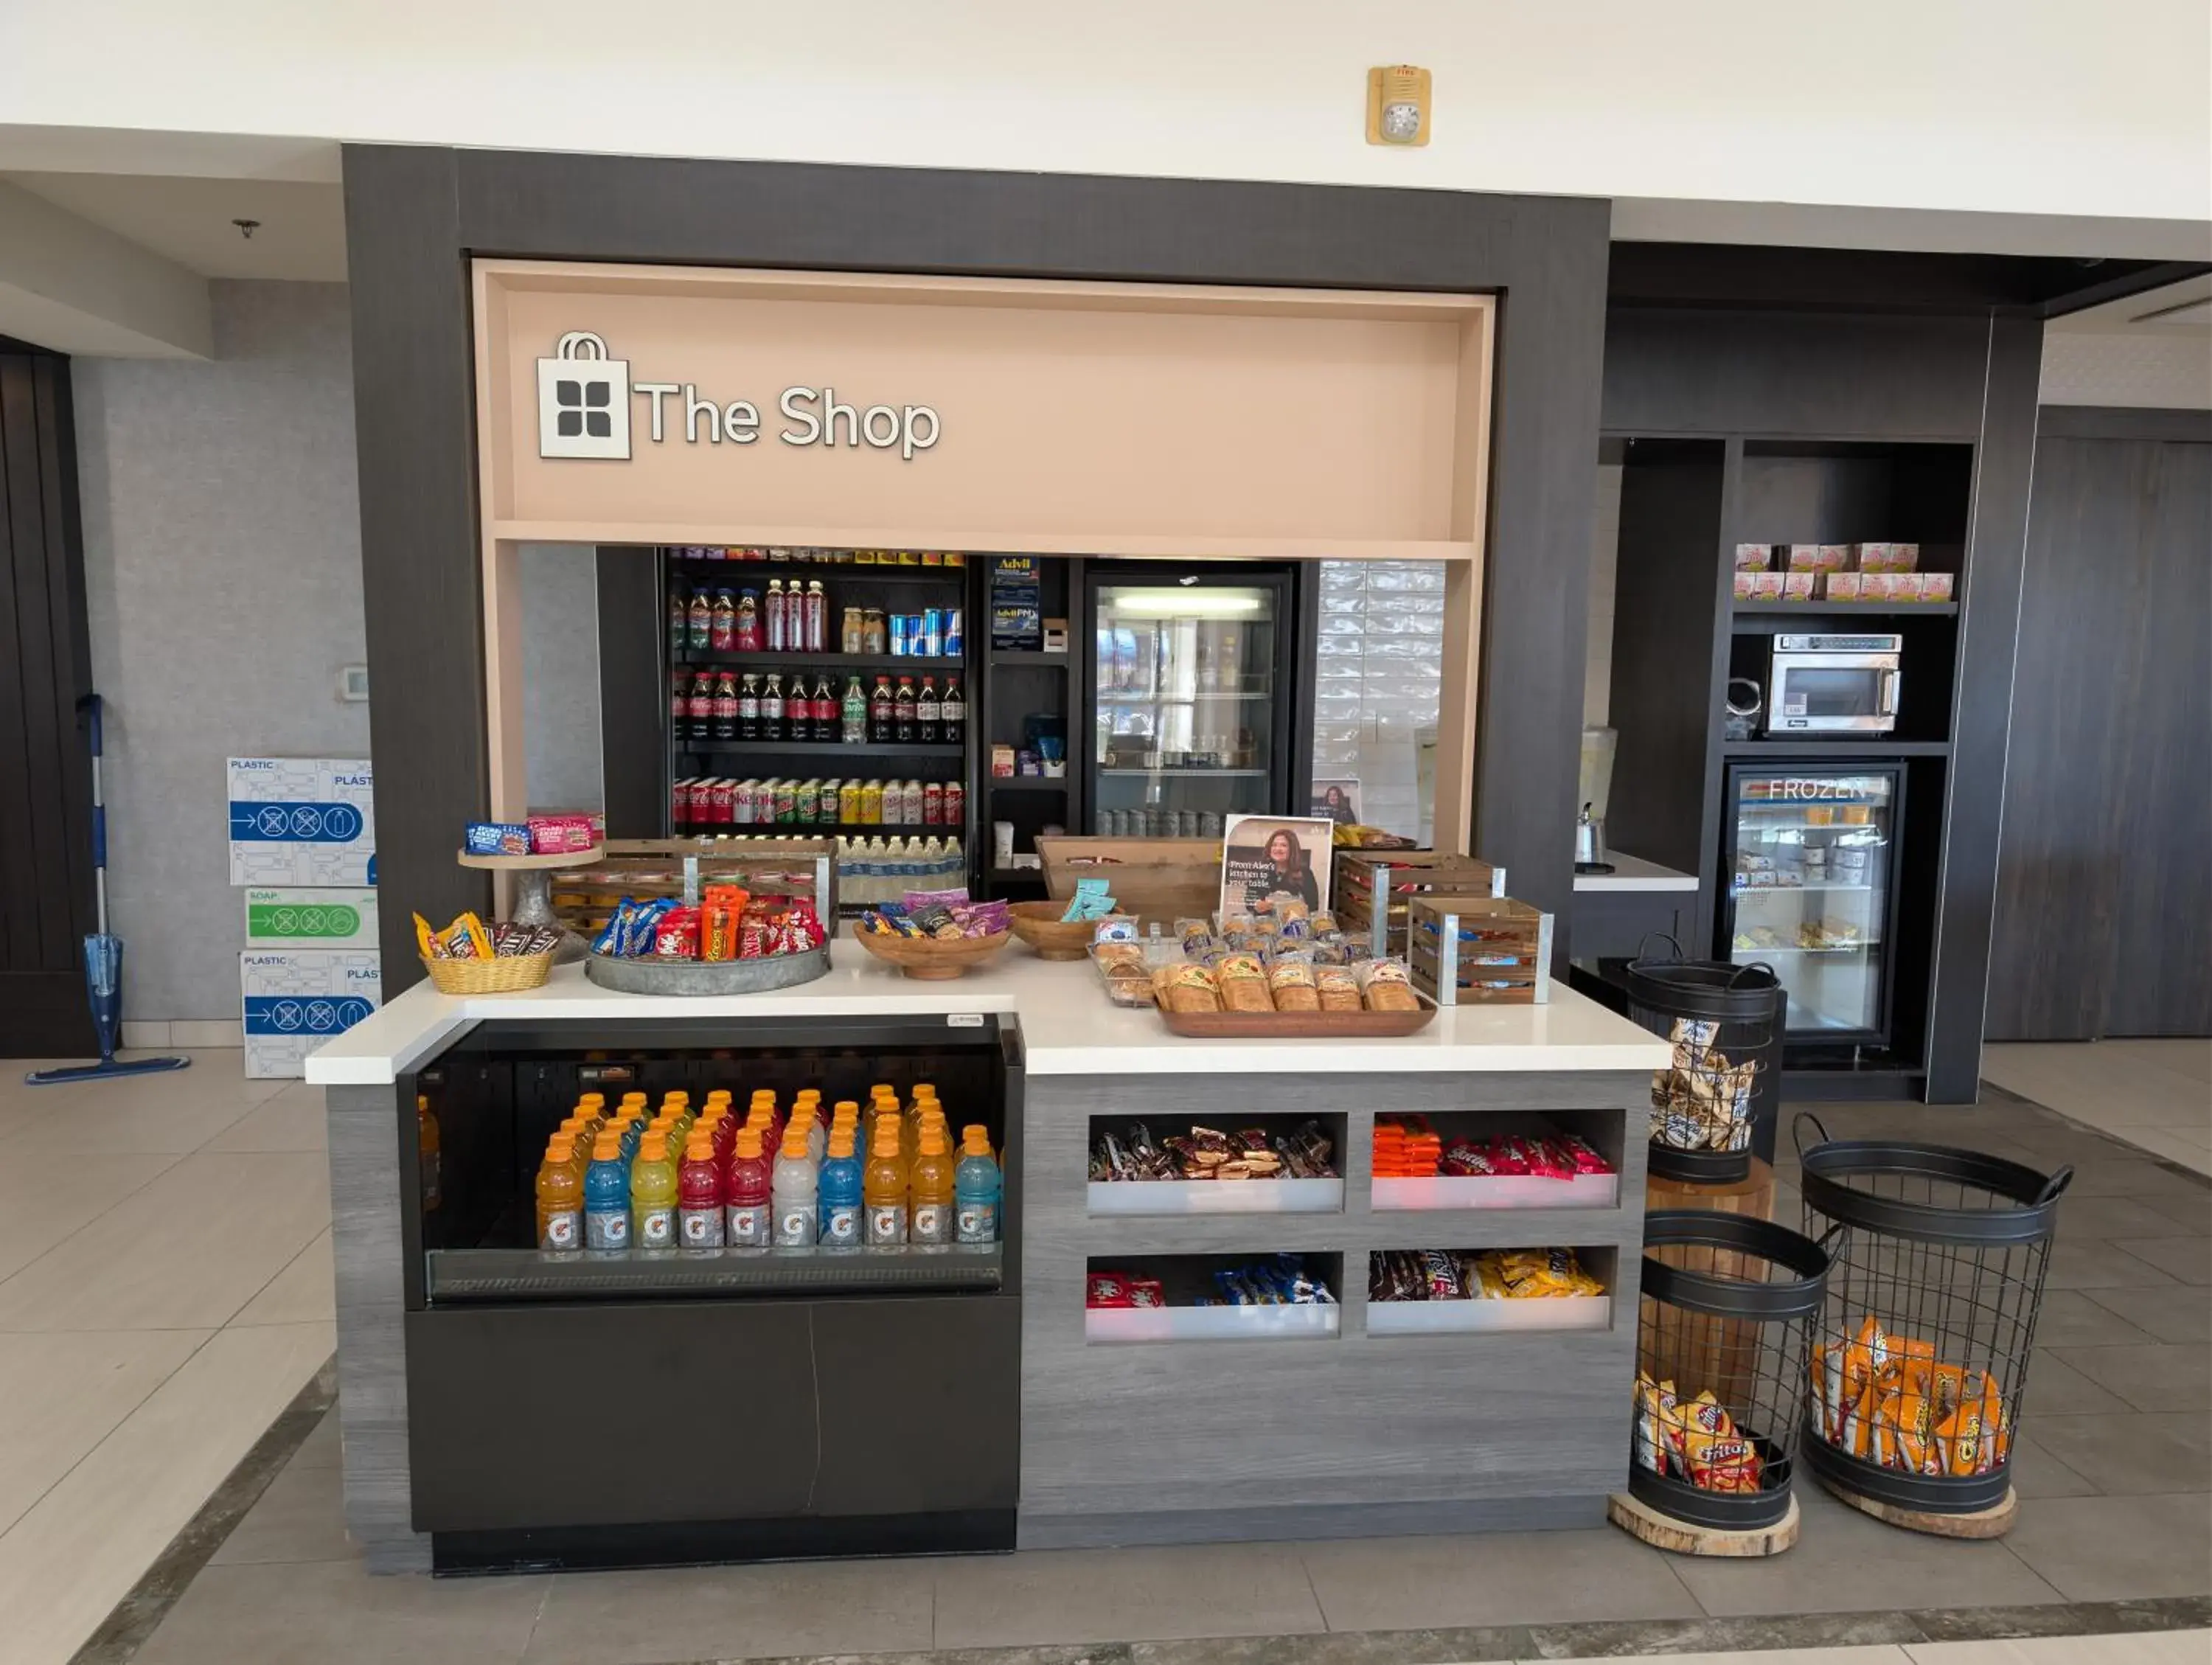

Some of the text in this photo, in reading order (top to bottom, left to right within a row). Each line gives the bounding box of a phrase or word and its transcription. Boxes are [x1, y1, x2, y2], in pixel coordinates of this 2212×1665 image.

[632, 382, 941, 460] The Shop
[999, 558, 1030, 569] Advil
[231, 760, 274, 769] PLASTIC
[334, 774, 373, 785] PLÁST
[1770, 779, 1866, 799] FROZEN
[1231, 861, 1251, 869] From
[244, 956, 287, 965] PLASTIC
[347, 967, 380, 979] PLÁS
